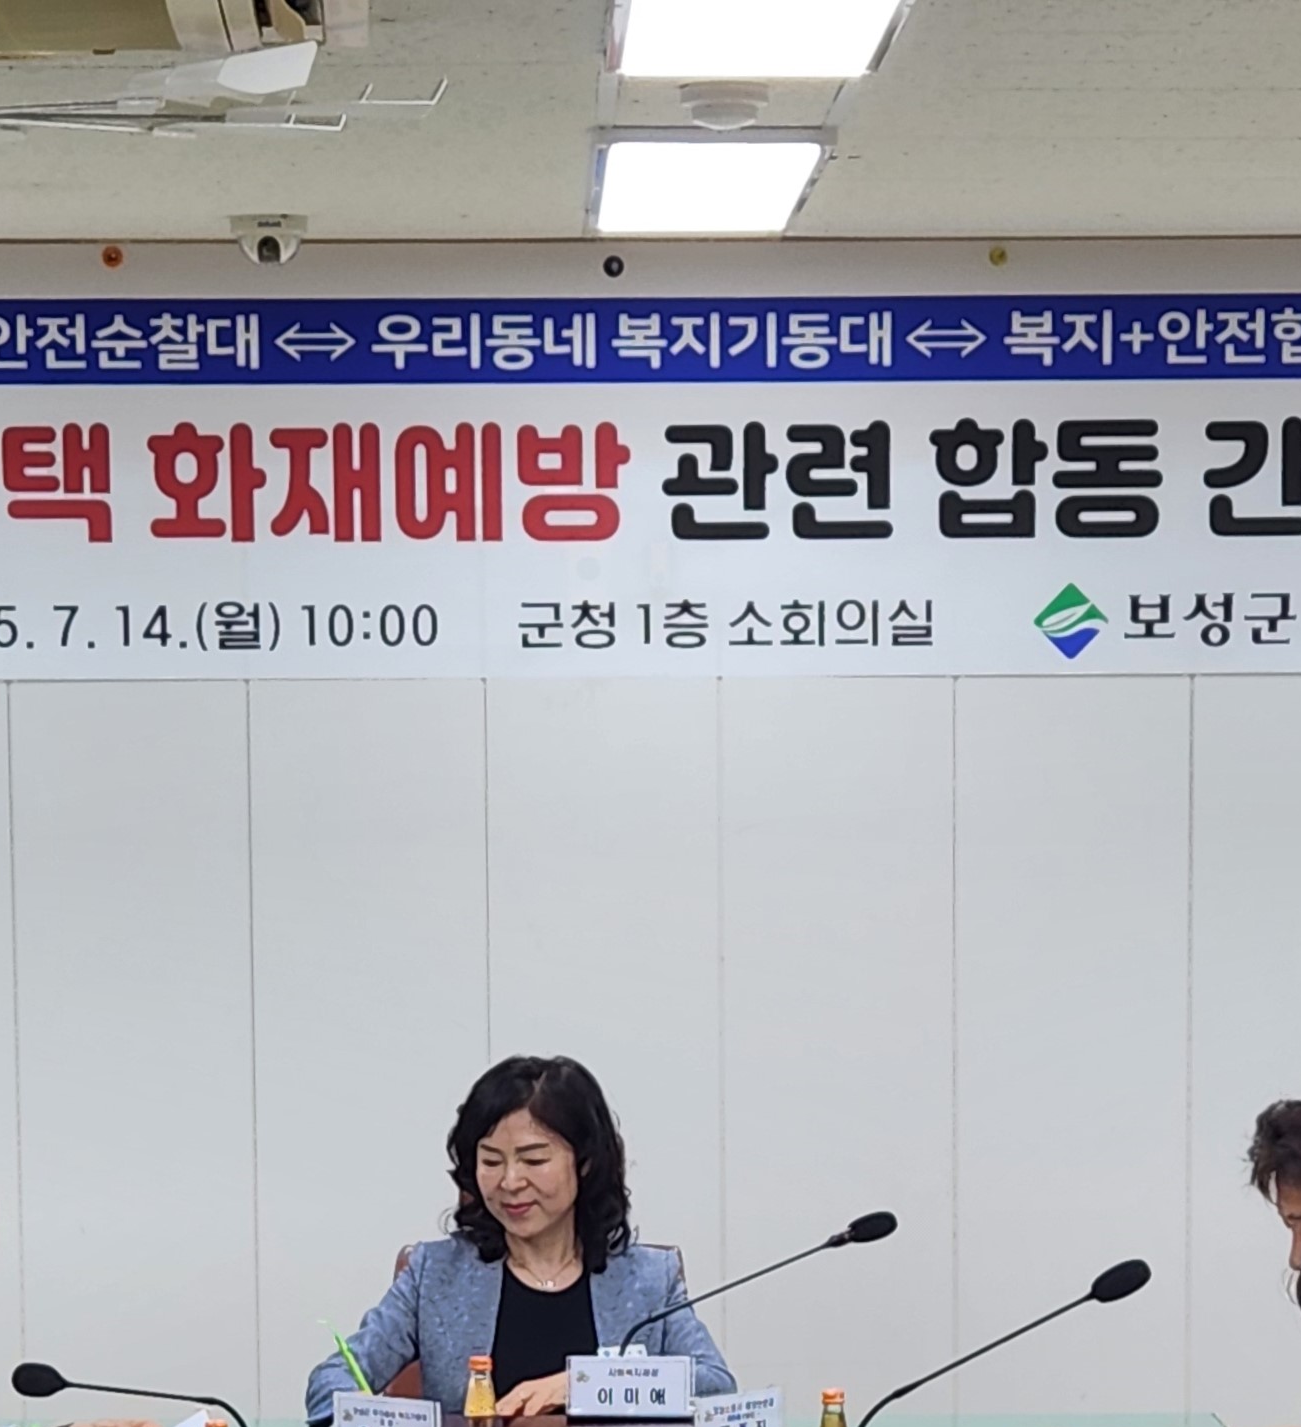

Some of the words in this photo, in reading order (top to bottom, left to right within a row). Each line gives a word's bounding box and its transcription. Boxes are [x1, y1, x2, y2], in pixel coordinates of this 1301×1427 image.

[370, 312, 598, 371] 우리동네
[611, 311, 894, 370] 복지기동대
[146, 421, 631, 545] 화재예방
[660, 419, 895, 542] 관련
[927, 416, 1164, 540] 합동
[301, 603, 439, 648] 10:00
[517, 600, 617, 650] 군청
[636, 599, 709, 650] 1층
[728, 599, 934, 648] 소회의실
[1123, 591, 1298, 648] 보성군
